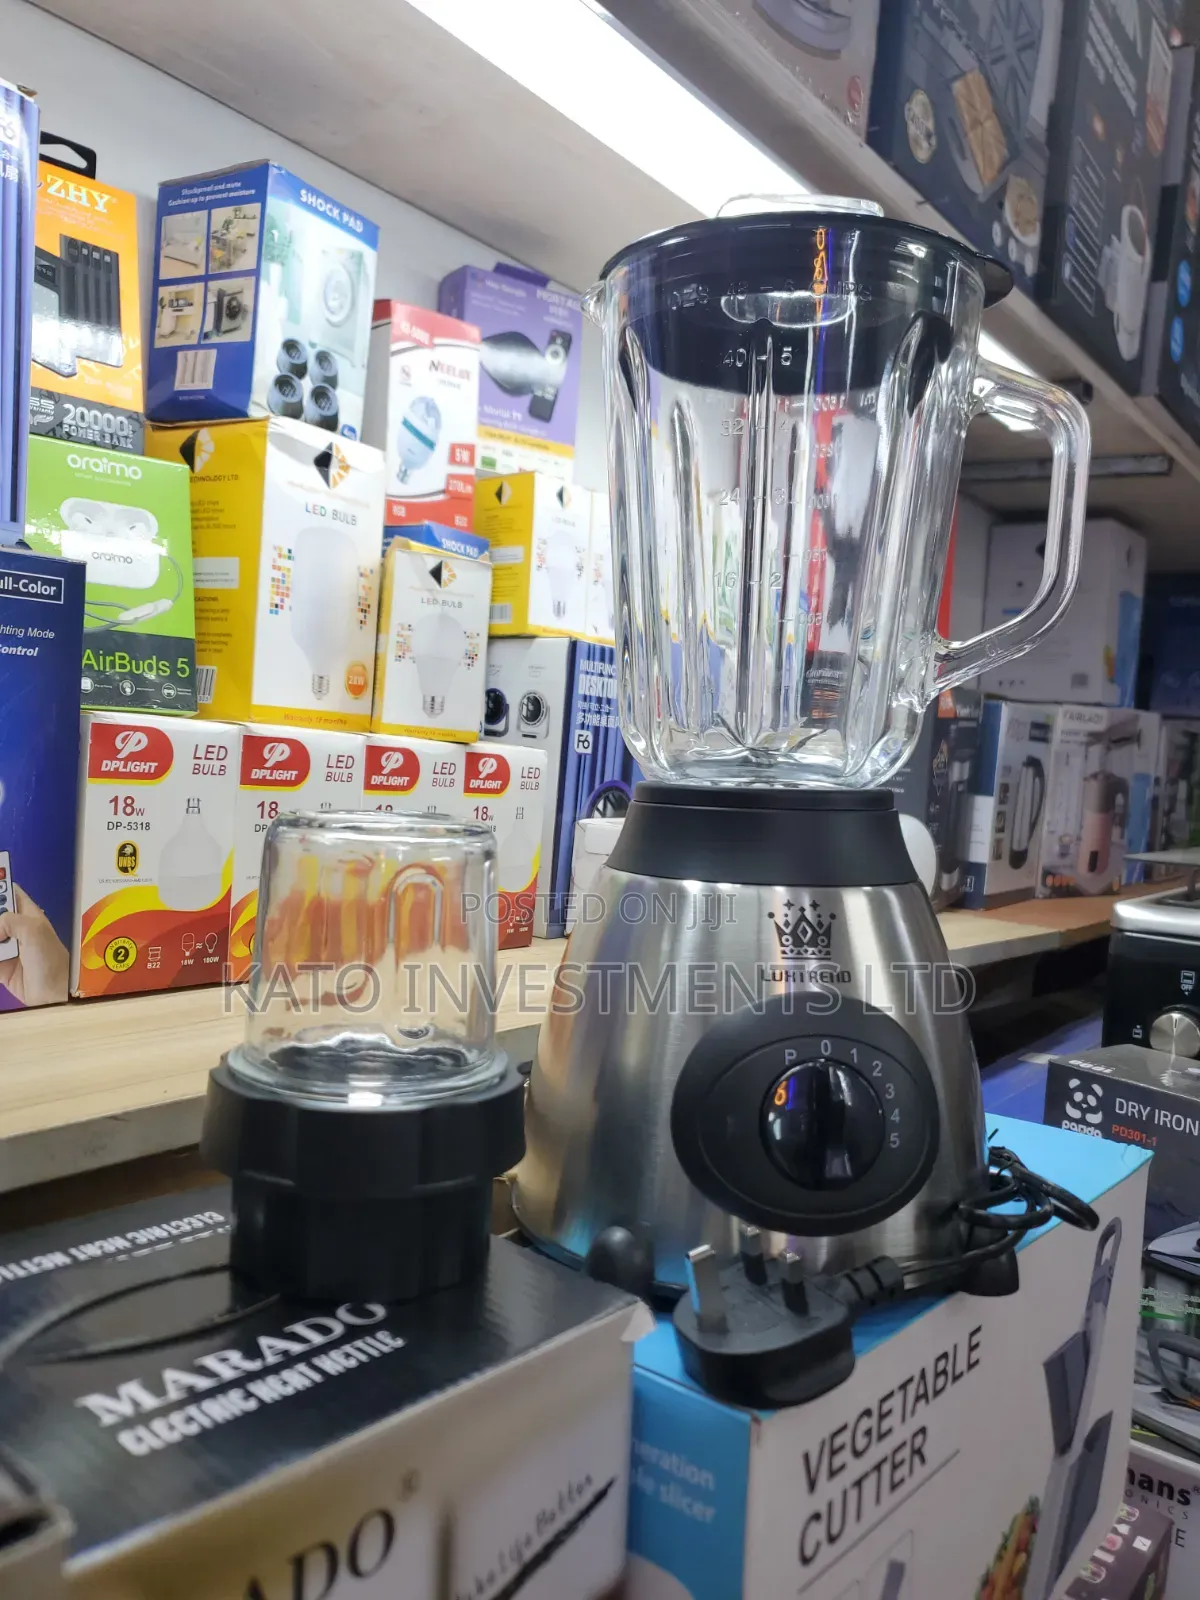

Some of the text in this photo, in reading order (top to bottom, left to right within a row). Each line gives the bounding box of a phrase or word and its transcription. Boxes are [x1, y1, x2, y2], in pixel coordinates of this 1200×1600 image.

[46, 174, 112, 213] ZHY
[300, 188, 364, 234] SHOCK PAD
[723, 346, 793, 367] 40 5
[62, 403, 129, 437] 20000
[104, 433, 134, 450] BANK
[66, 454, 142, 480] oraimo
[718, 488, 741, 506] 24
[305, 501, 357, 526] LED BULB
[441, 538, 479, 558] SHOCK PAD
[91, 550, 133, 565] oraimo
[770, 572, 783, 590] 2
[421, 597, 463, 609] LED BULB
[27, 626, 55, 639] Mode
[0, 644, 39, 657] ontrol
[82, 649, 190, 678] AirBuds 5
[283, 712, 313, 724] Warranty
[576, 733, 591, 750] F6
[193, 744, 229, 761] LED
[100, 759, 158, 773] DPLIGHT
[192, 763, 227, 776] BULB
[326, 754, 355, 769] LED
[432, 761, 457, 776] LED
[250, 768, 298, 781] DPLIGHT
[325, 771, 353, 783] BULB
[370, 774, 410, 787] DPLIGHT
[520, 766, 541, 780] LED
[432, 776, 456, 788] BULB
[469, 778, 502, 791] DPLIGHT
[520, 780, 540, 791] BULB
[106, 821, 151, 832] DP-5318
[118, 855, 136, 868] UNBS
[108, 939, 135, 951] Warranty
[117, 949, 125, 961] 2
[180, 956, 220, 967] 18W 180W
[112, 962, 130, 970] YEARS
[147, 961, 161, 970] B22
[820, 1039, 832, 1056] 0
[850, 1047, 859, 1064] 1
[784, 1049, 797, 1066] P
[872, 1060, 882, 1077] 2
[885, 1083, 895, 1099] 3
[890, 1108, 900, 1124] 4
[1115, 1097, 1200, 1137] DRY IRON
[889, 1133, 900, 1149] 5
[1112, 1124, 1157, 1147] PD301-1
[75, 1303, 389, 1428] MARADO
[801, 1324, 983, 1496] VEGETABLE
[660, 1479, 717, 1524] slicer
[798, 1424, 928, 1567] CUTTER
